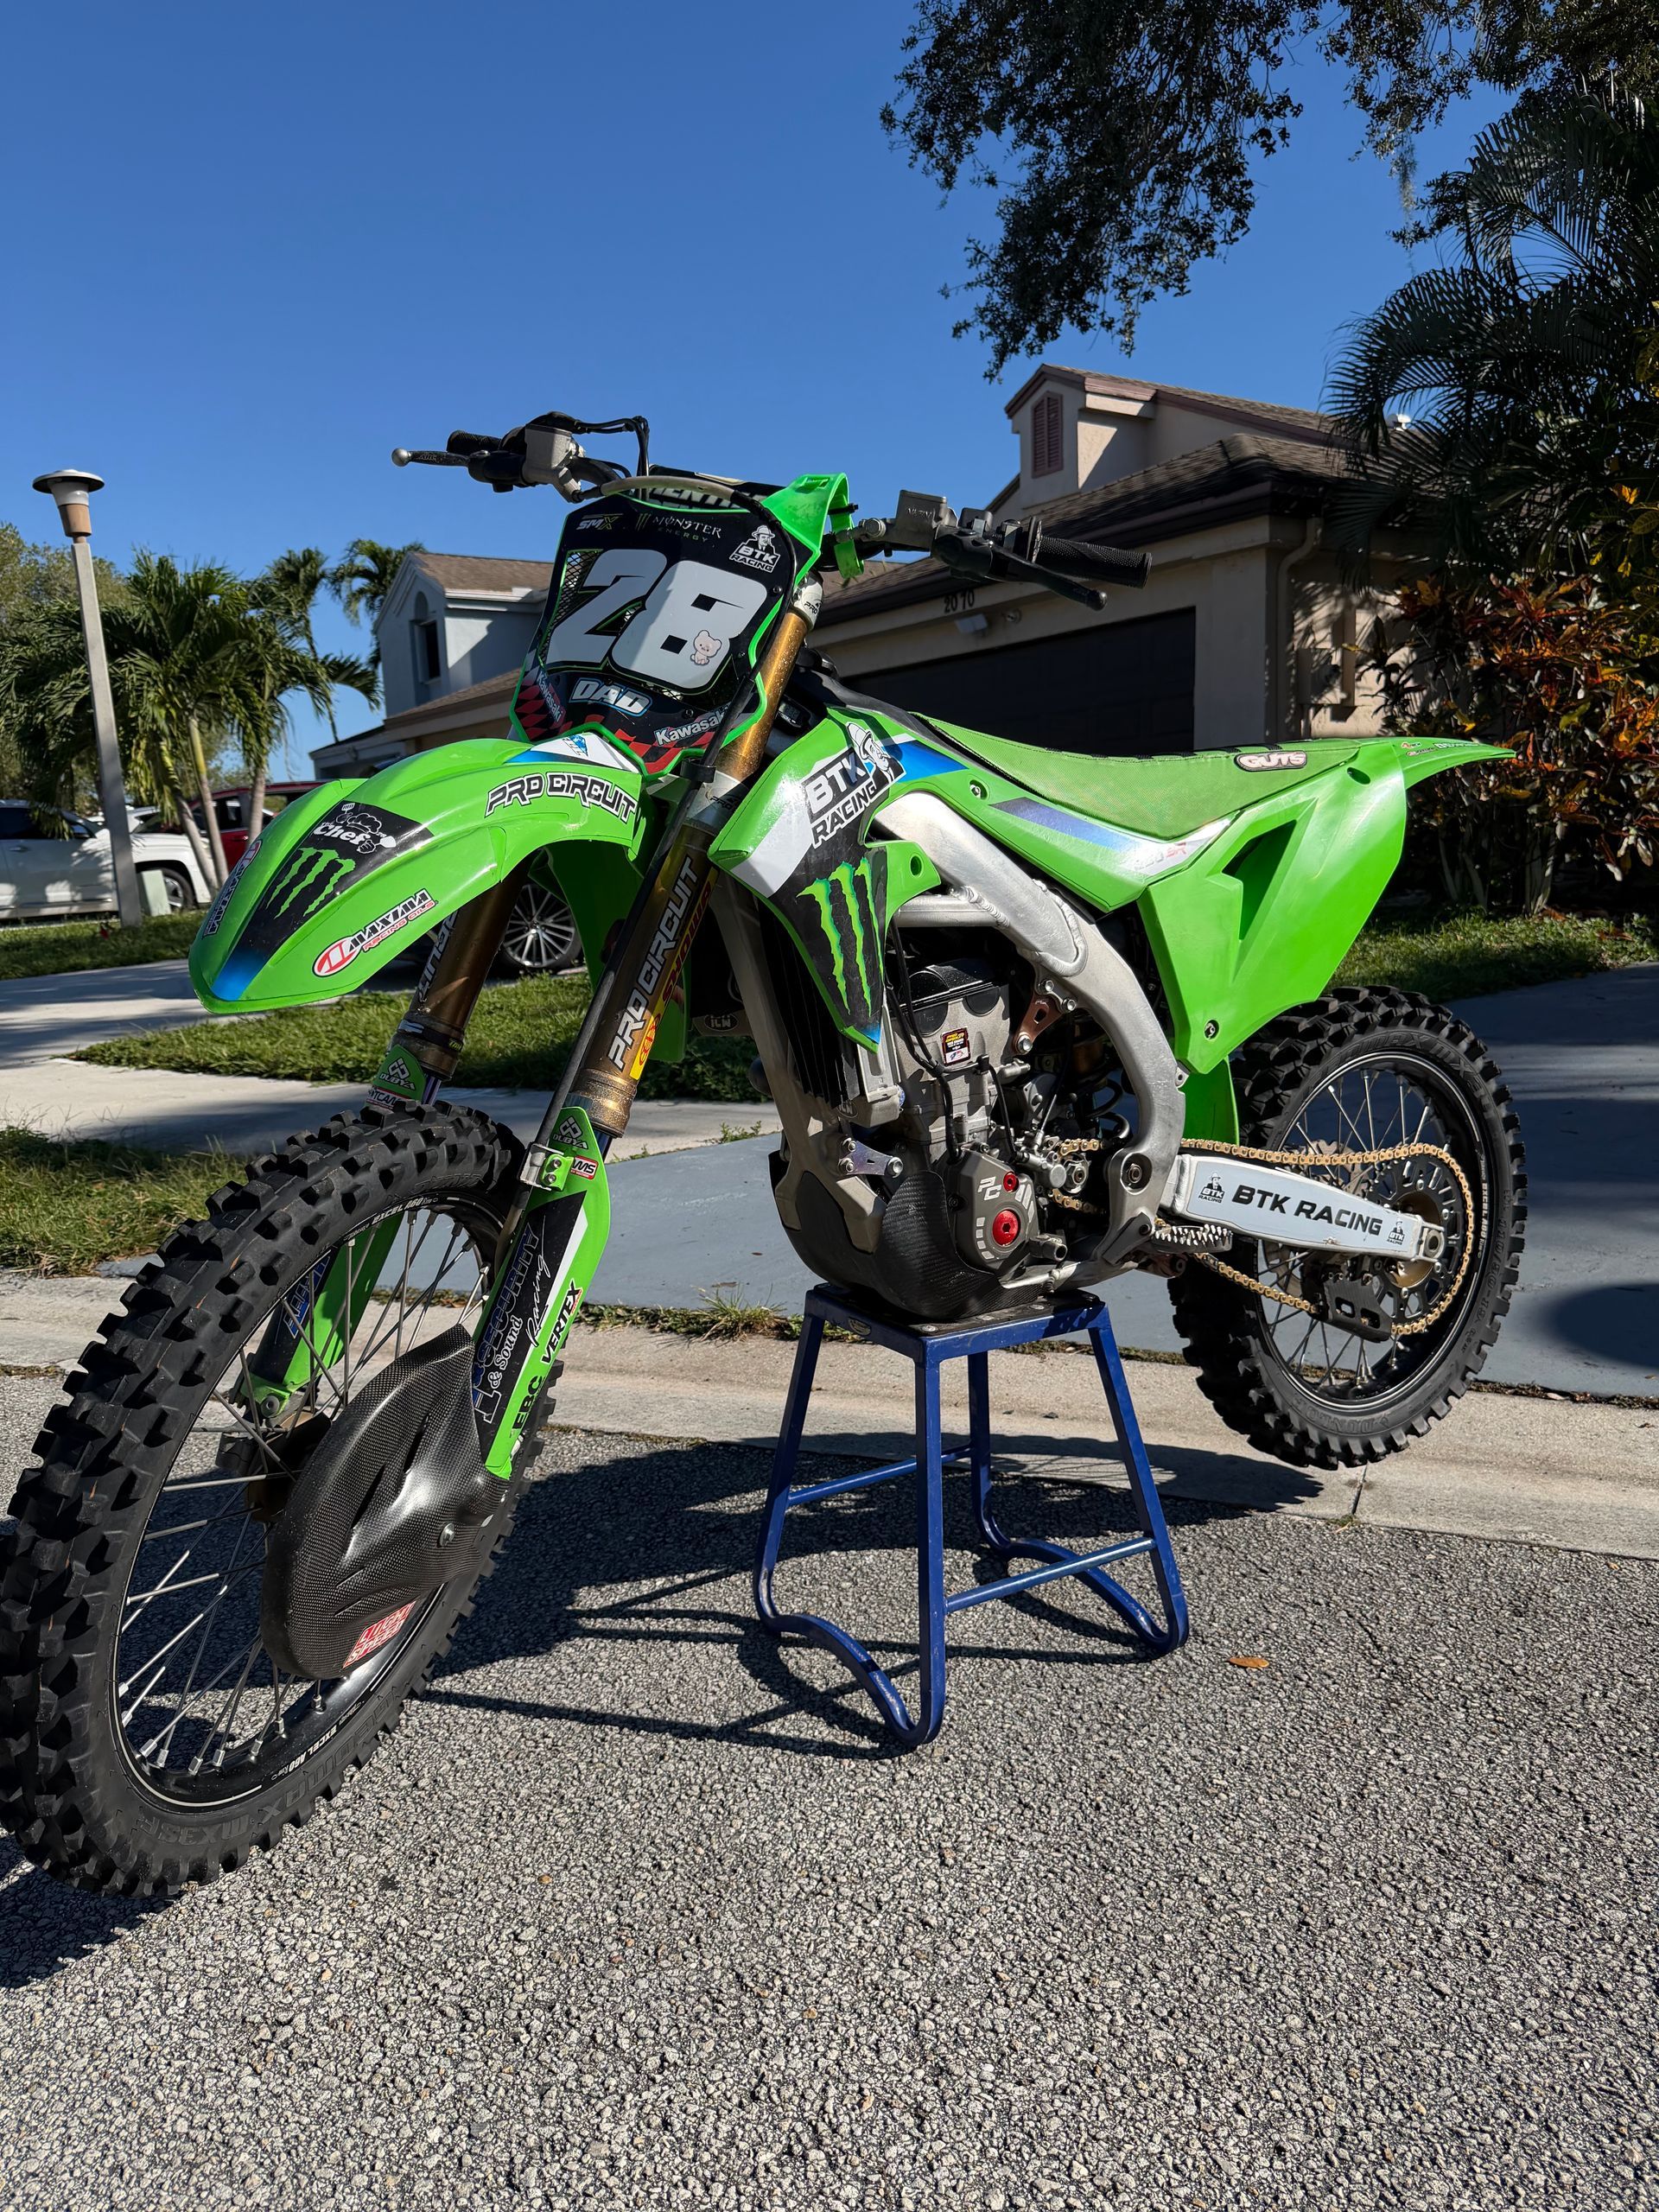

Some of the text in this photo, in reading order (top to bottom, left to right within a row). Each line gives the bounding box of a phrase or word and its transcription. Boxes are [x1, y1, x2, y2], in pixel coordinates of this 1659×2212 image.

[652, 516, 721, 538] MONSTER
[658, 527, 709, 542] ENERGY
[730, 554, 775, 572] RACING
[738, 545, 777, 564] BTK
[546, 549, 767, 690] 28
[944, 589, 975, 613] 2070
[571, 680, 651, 714] DAD
[656, 707, 729, 745] Kawasak
[1237, 752, 1306, 769] GUTS
[486, 774, 636, 822] PRO CIRCUIT
[811, 753, 869, 810] BTK
[812, 779, 877, 848] RACING
[313, 824, 371, 845] Chef
[363, 900, 435, 951] RACING OILS
[607, 856, 697, 1071] PRO CIRCUIT
[553, 1134, 588, 1149] DUBYA
[1201, 1188, 1224, 1198] BTK
[1231, 1185, 1382, 1236] BTK RACING
[526, 1215, 550, 1347] Racing
[541, 1279, 581, 1364] VERTEX
[488, 1314, 523, 1389] & Sound
[512, 1375, 543, 1429] EBC
[308, 1724, 338, 1758] EXCEL
